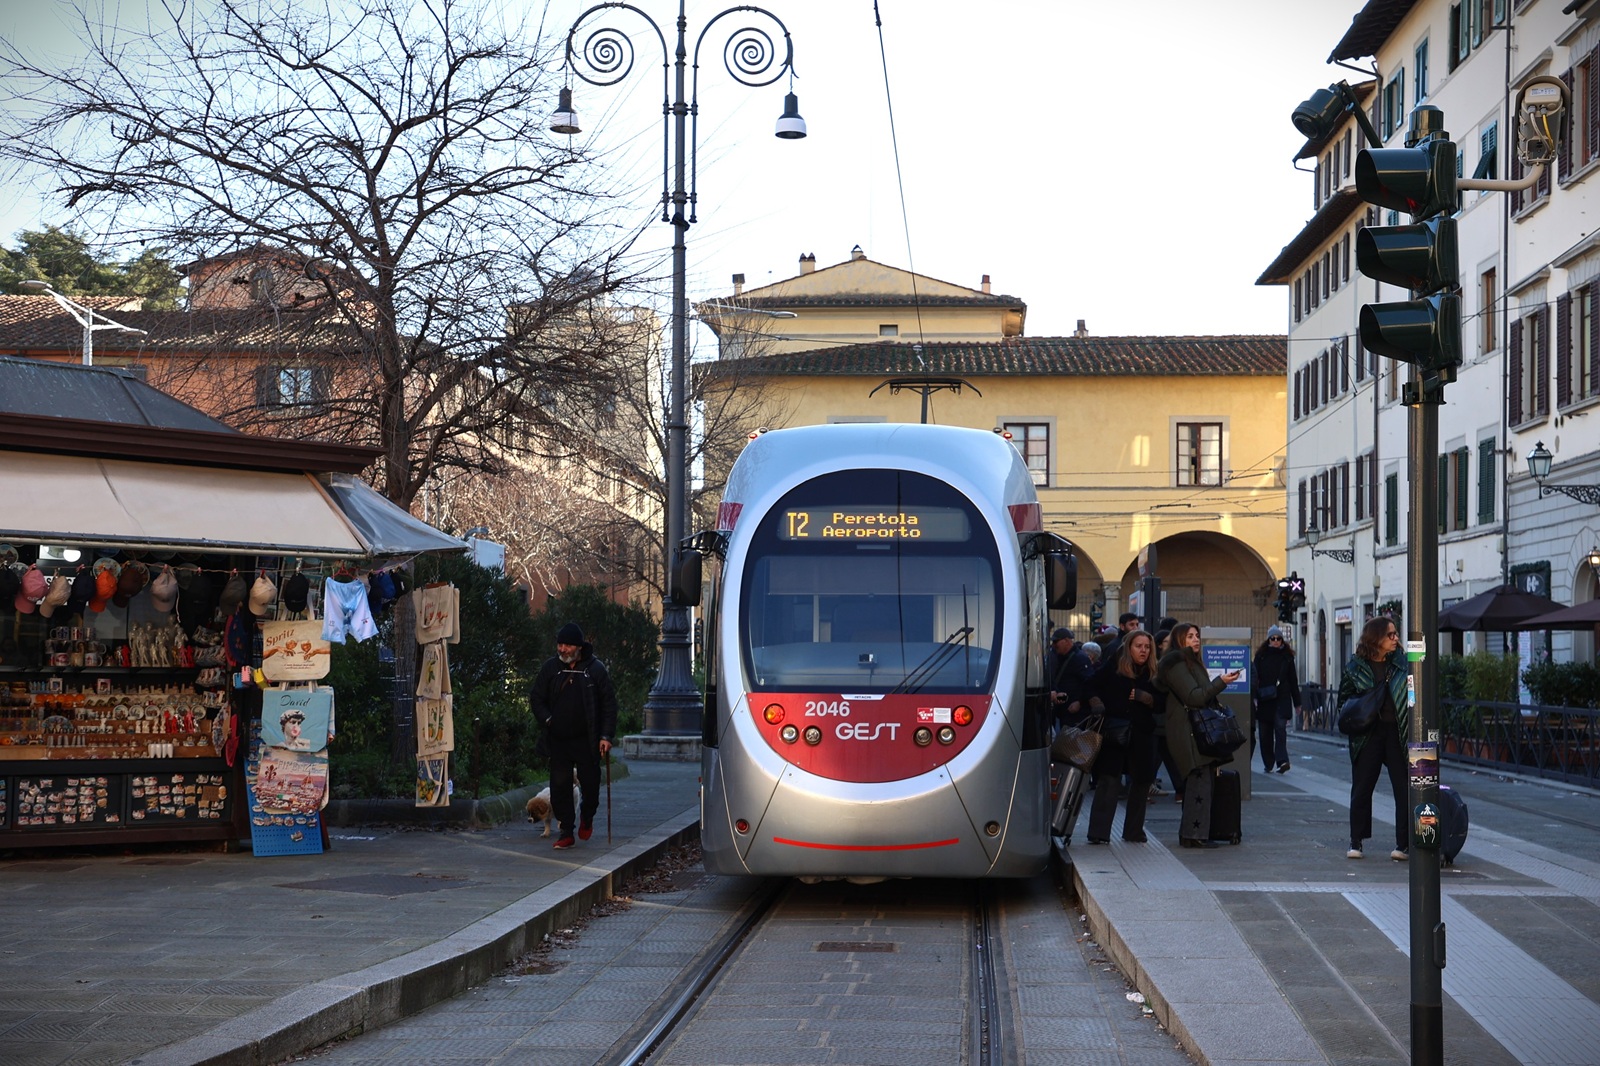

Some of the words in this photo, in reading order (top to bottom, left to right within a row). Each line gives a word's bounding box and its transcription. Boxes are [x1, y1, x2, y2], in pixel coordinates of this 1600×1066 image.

[787, 512, 810, 537] T2
[832, 512, 919, 525] Peretola
[822, 525, 921, 538] Aeroporto
[266, 629, 295, 647] Spritz
[280, 694, 311, 707] David
[804, 701, 850, 717] 2046
[835, 722, 901, 741] GEST
